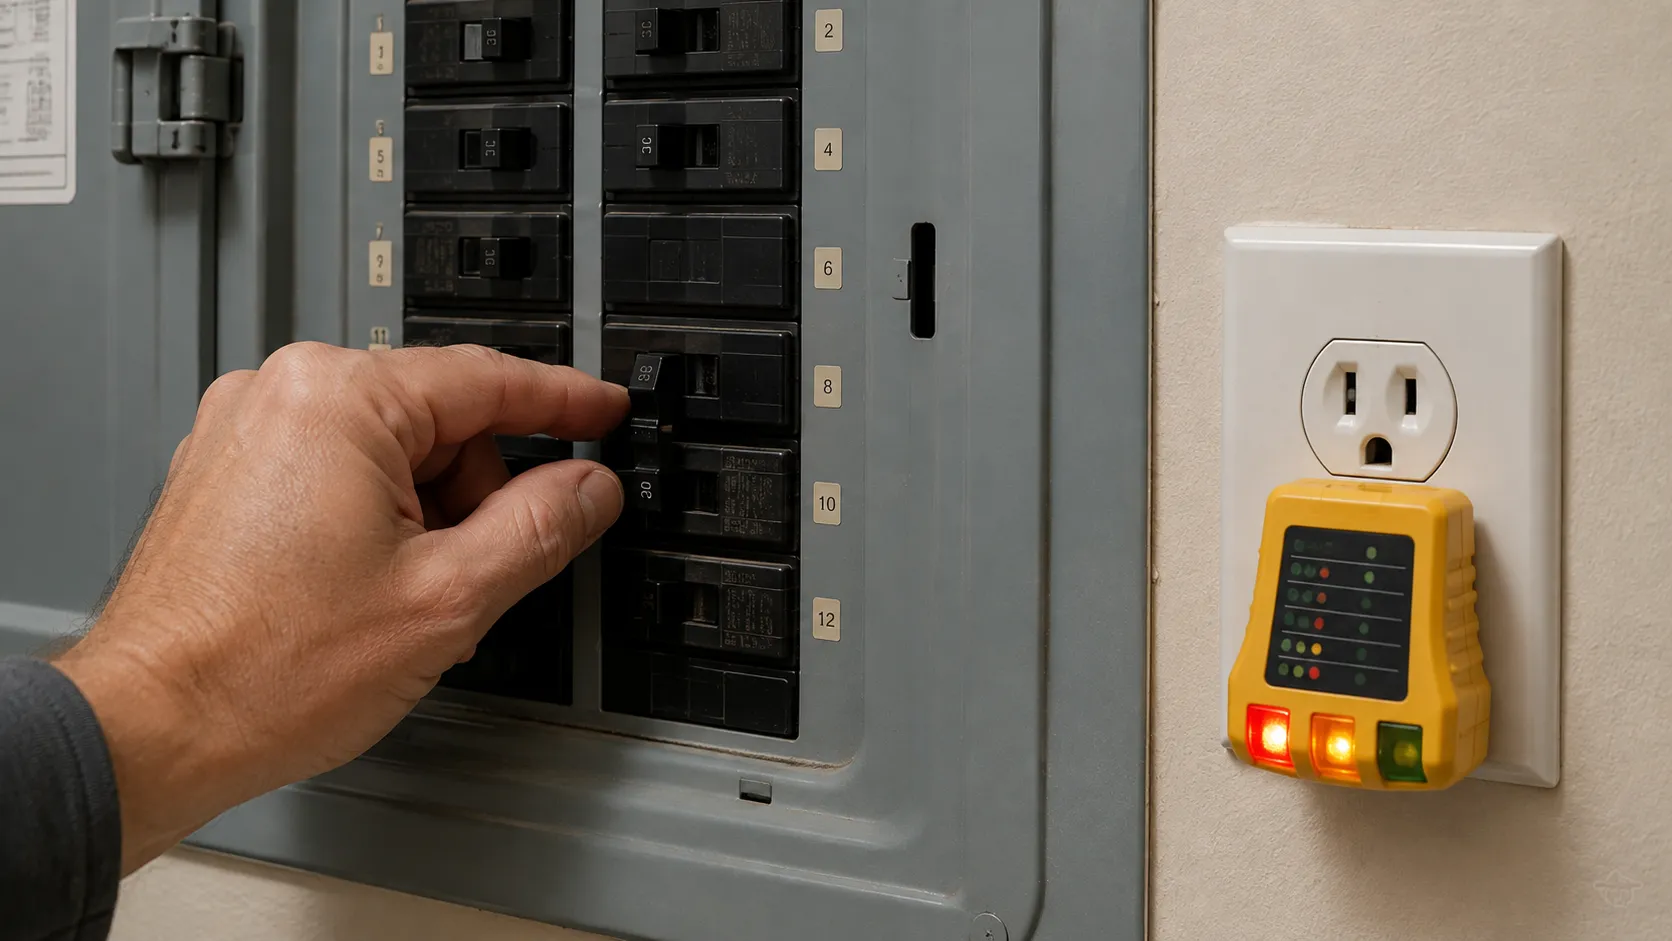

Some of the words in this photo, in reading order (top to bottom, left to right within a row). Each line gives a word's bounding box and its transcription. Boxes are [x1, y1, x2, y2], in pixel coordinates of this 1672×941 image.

[824, 22, 834, 39] 2
[377, 149, 384, 164] 5
[823, 142, 833, 157] 4
[823, 260, 833, 276] 6
[823, 378, 833, 395] 8
[819, 495, 836, 512] 10
[818, 611, 835, 628] 12
